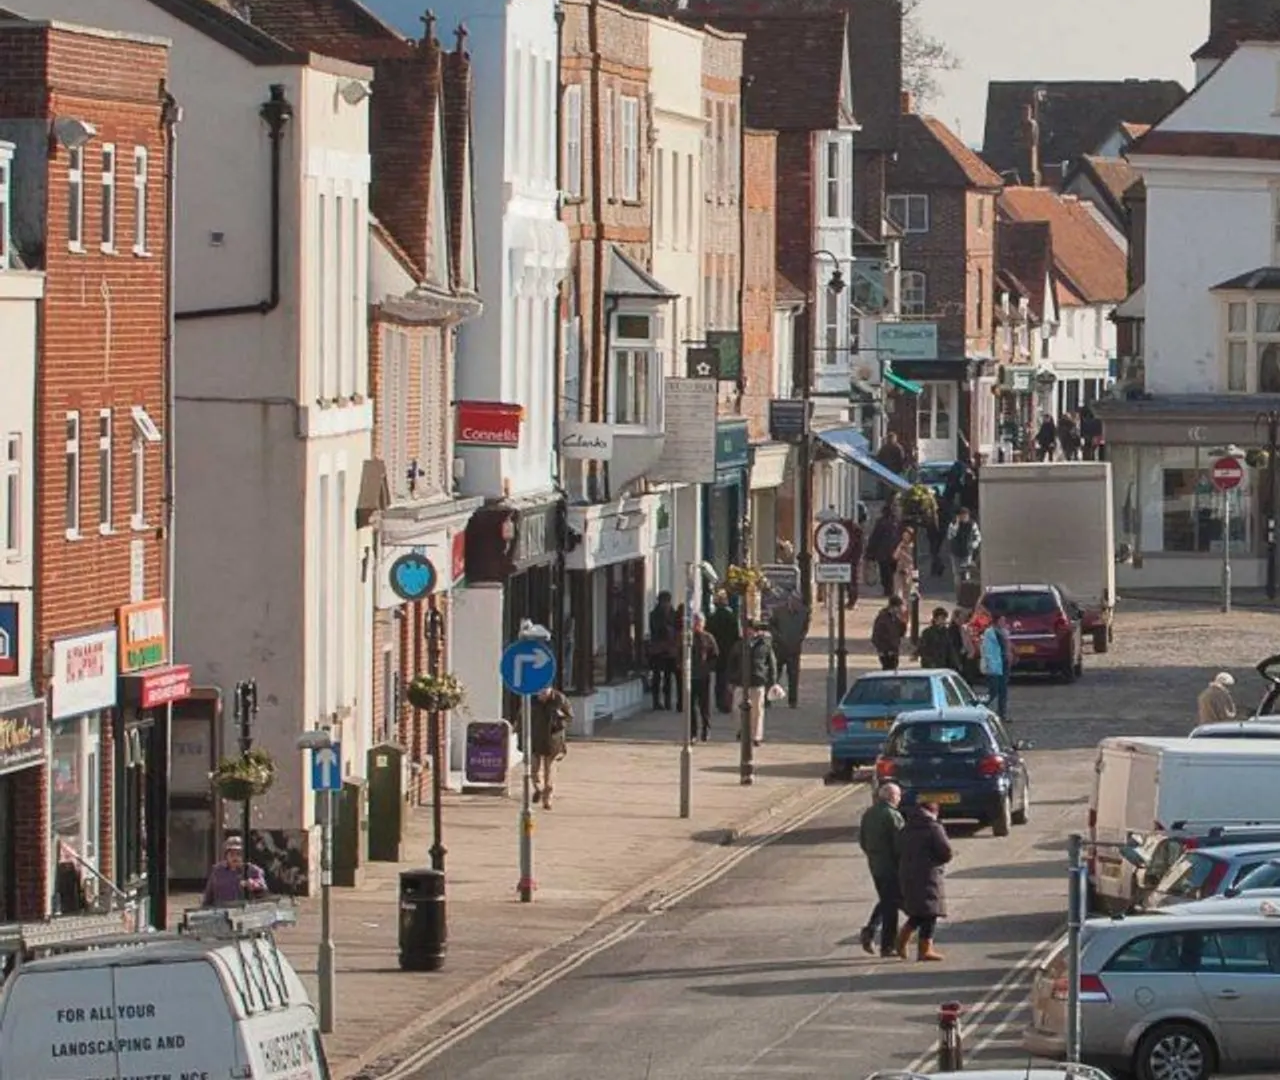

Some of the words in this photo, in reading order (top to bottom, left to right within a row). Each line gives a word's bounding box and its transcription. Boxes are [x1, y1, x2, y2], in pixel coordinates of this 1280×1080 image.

[462, 427, 518, 441] Connells
[562, 434, 607, 448] Clarks
[57, 1008, 85, 1024] FOR
[90, 1005, 115, 1021] ALL
[117, 1003, 156, 1020] YOUR
[51, 1039, 152, 1058] LANDSCAPING
[156, 1035, 186, 1051] AND
